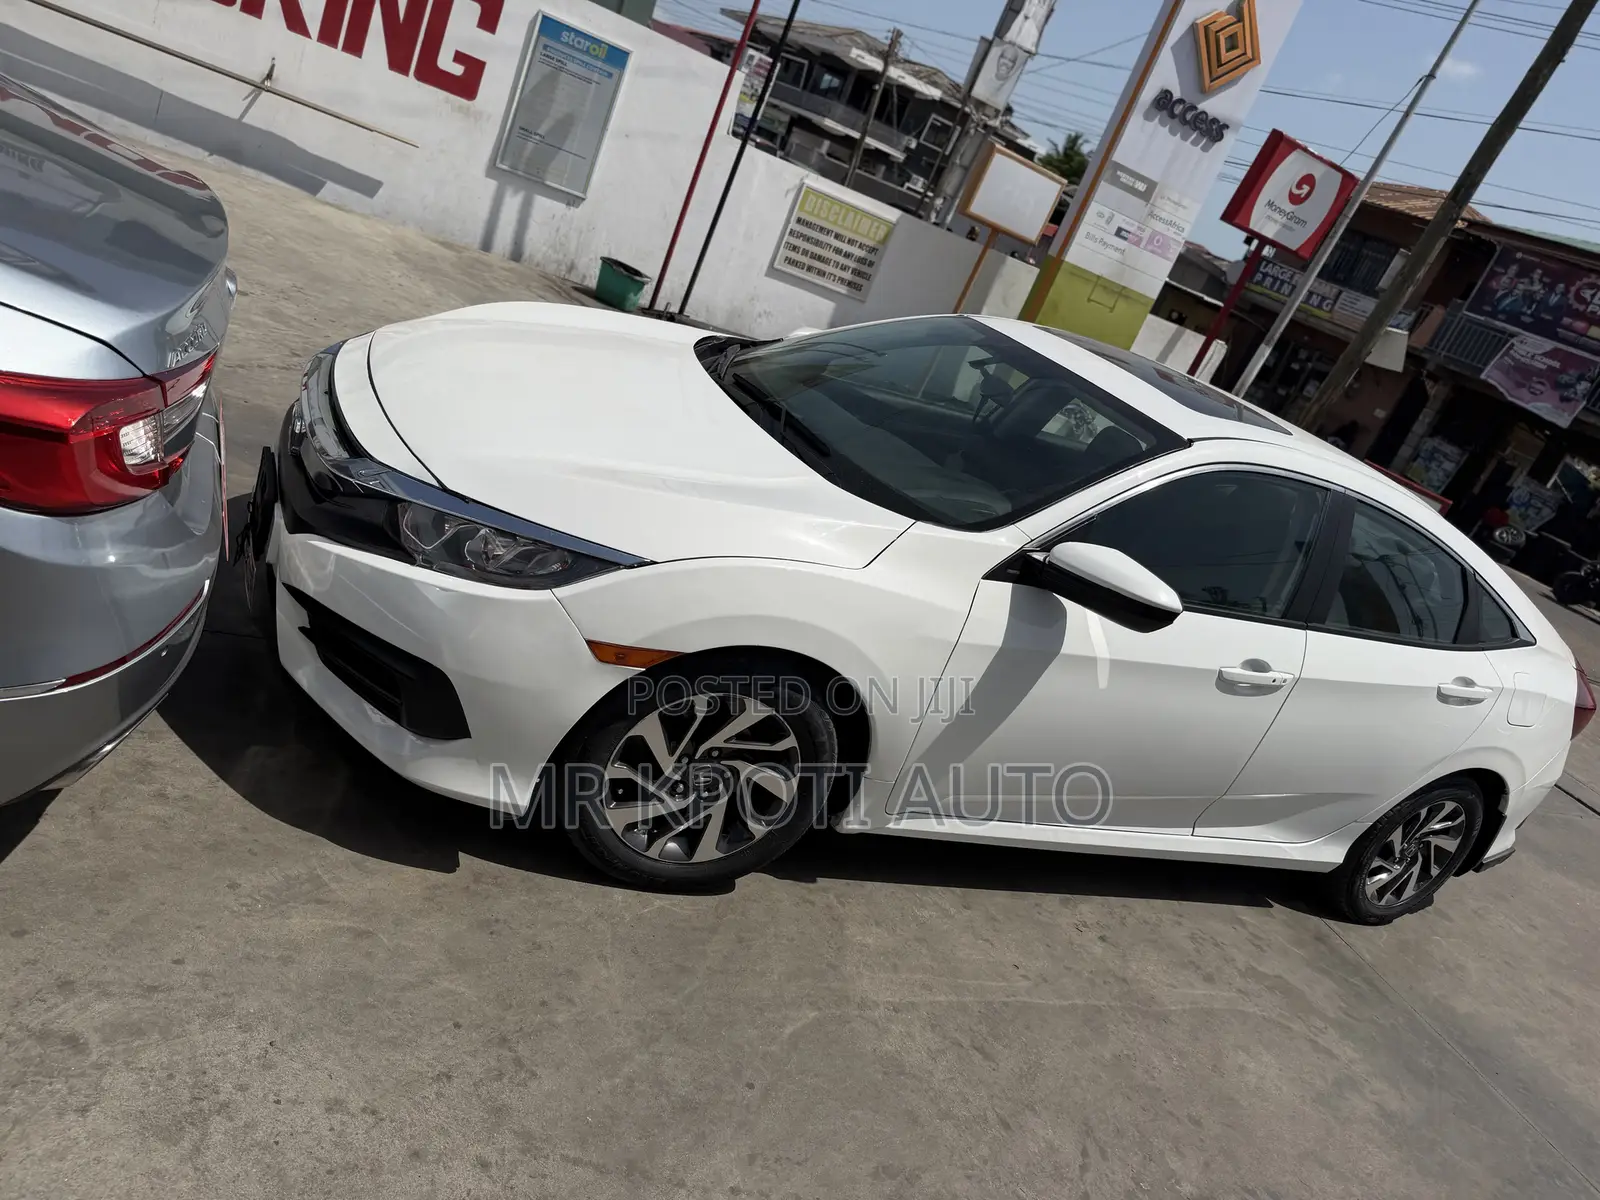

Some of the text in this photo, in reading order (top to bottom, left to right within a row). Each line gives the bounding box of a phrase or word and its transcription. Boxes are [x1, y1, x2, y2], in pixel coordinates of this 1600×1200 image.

[561, 30, 609, 59] staroil
[1153, 89, 1230, 142] access
[804, 192, 887, 241] DISCLAIMER
[1147, 211, 1185, 234] AccessAfrica
[1264, 199, 1308, 228] MoneyGram
[788, 228, 876, 269] RESPONSIBILITY FOR ANY LOSS OF
[795, 216, 879, 256] MANAGEMENT WILL NOT ACCEPT
[1085, 231, 1098, 243] Bills
[1098, 237, 1126, 256] Payment
[783, 241, 872, 281] ITEMS OR DAMAGE TO ANY VEHICLE
[783, 256, 863, 292] PARKED WITHIN IT'S PREMISES
[1259, 260, 1292, 281] LARGE
[1253, 271, 1333, 312] PRINING
